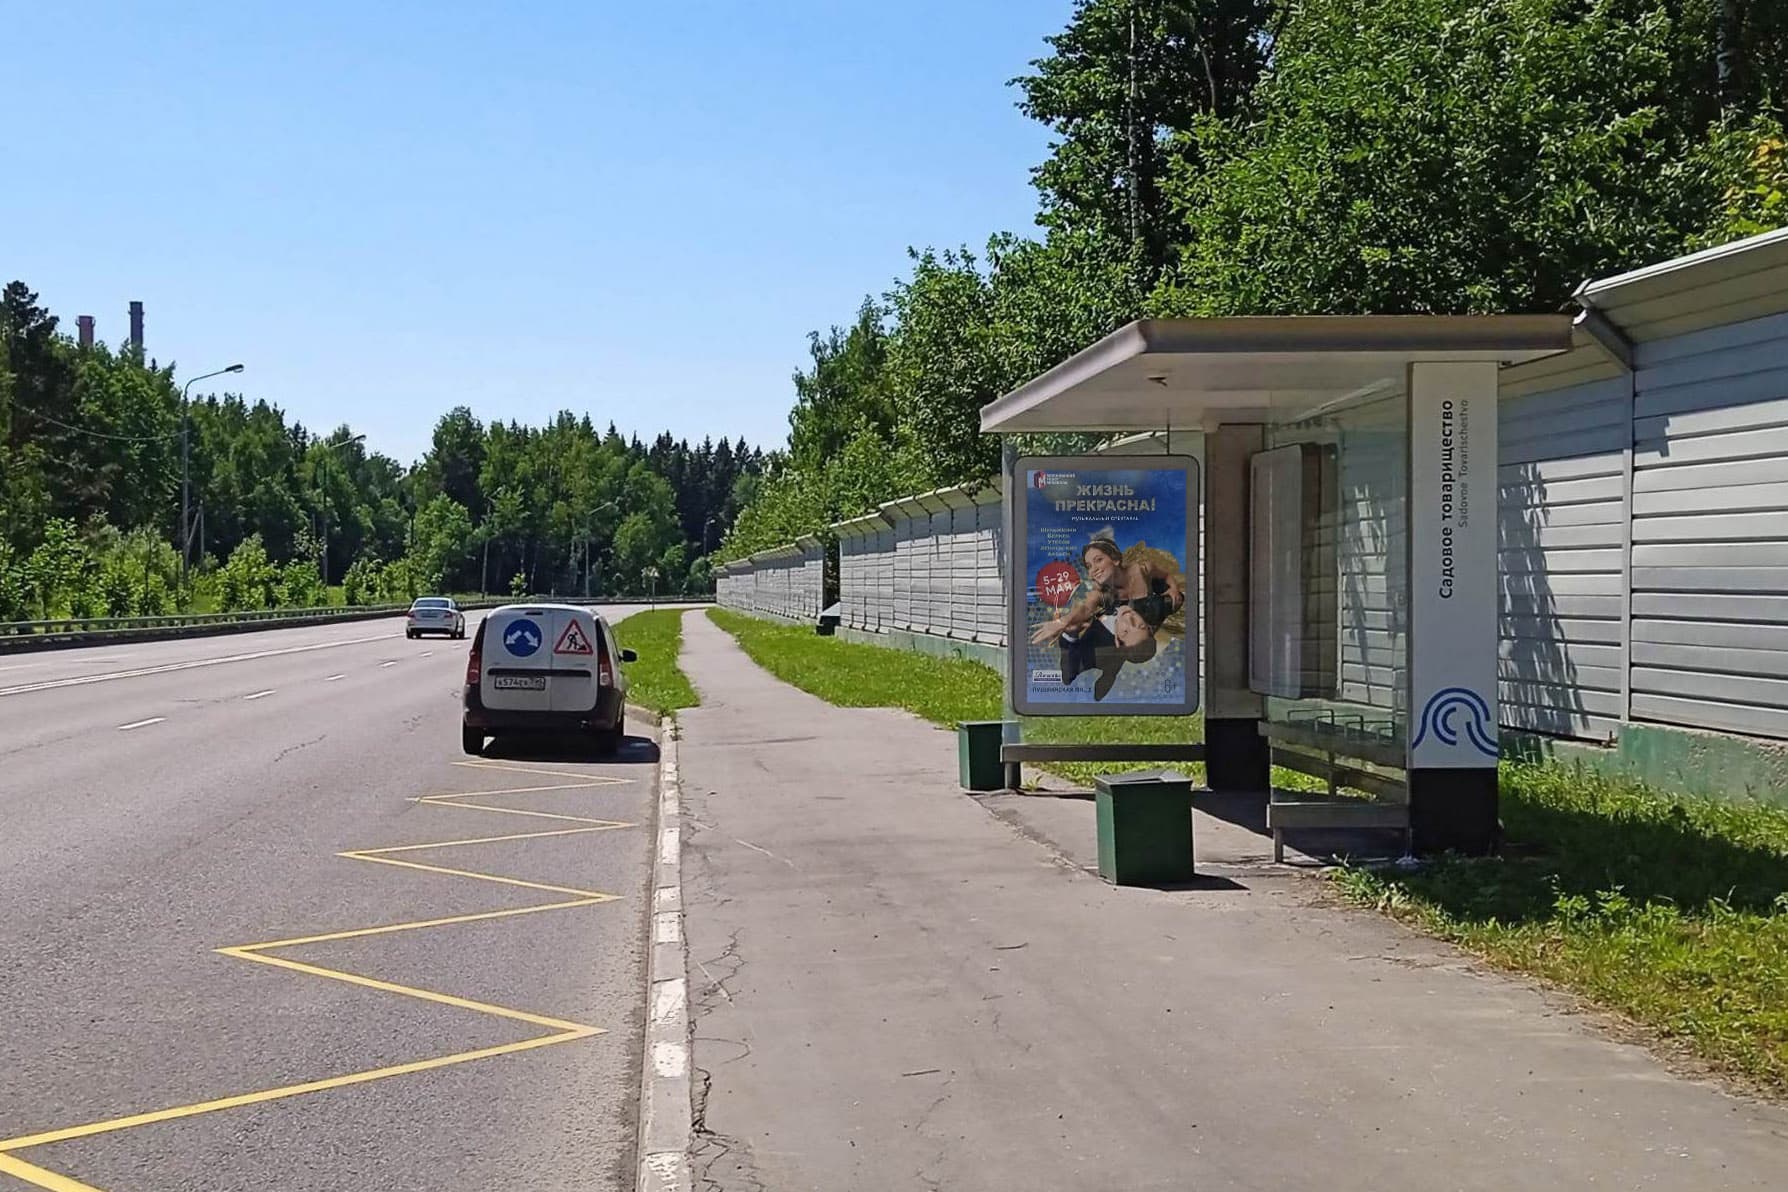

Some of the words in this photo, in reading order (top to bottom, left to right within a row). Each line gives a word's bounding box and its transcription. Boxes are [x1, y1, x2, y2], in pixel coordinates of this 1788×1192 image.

[1440, 400, 1455, 521] товарищество
[1076, 484, 1134, 496] ЖИЗНЬ
[1055, 498, 1156, 512] ПРЕКРАСНА!
[1438, 527, 1454, 599] Садовое
[1045, 582, 1072, 596] МАЯ
